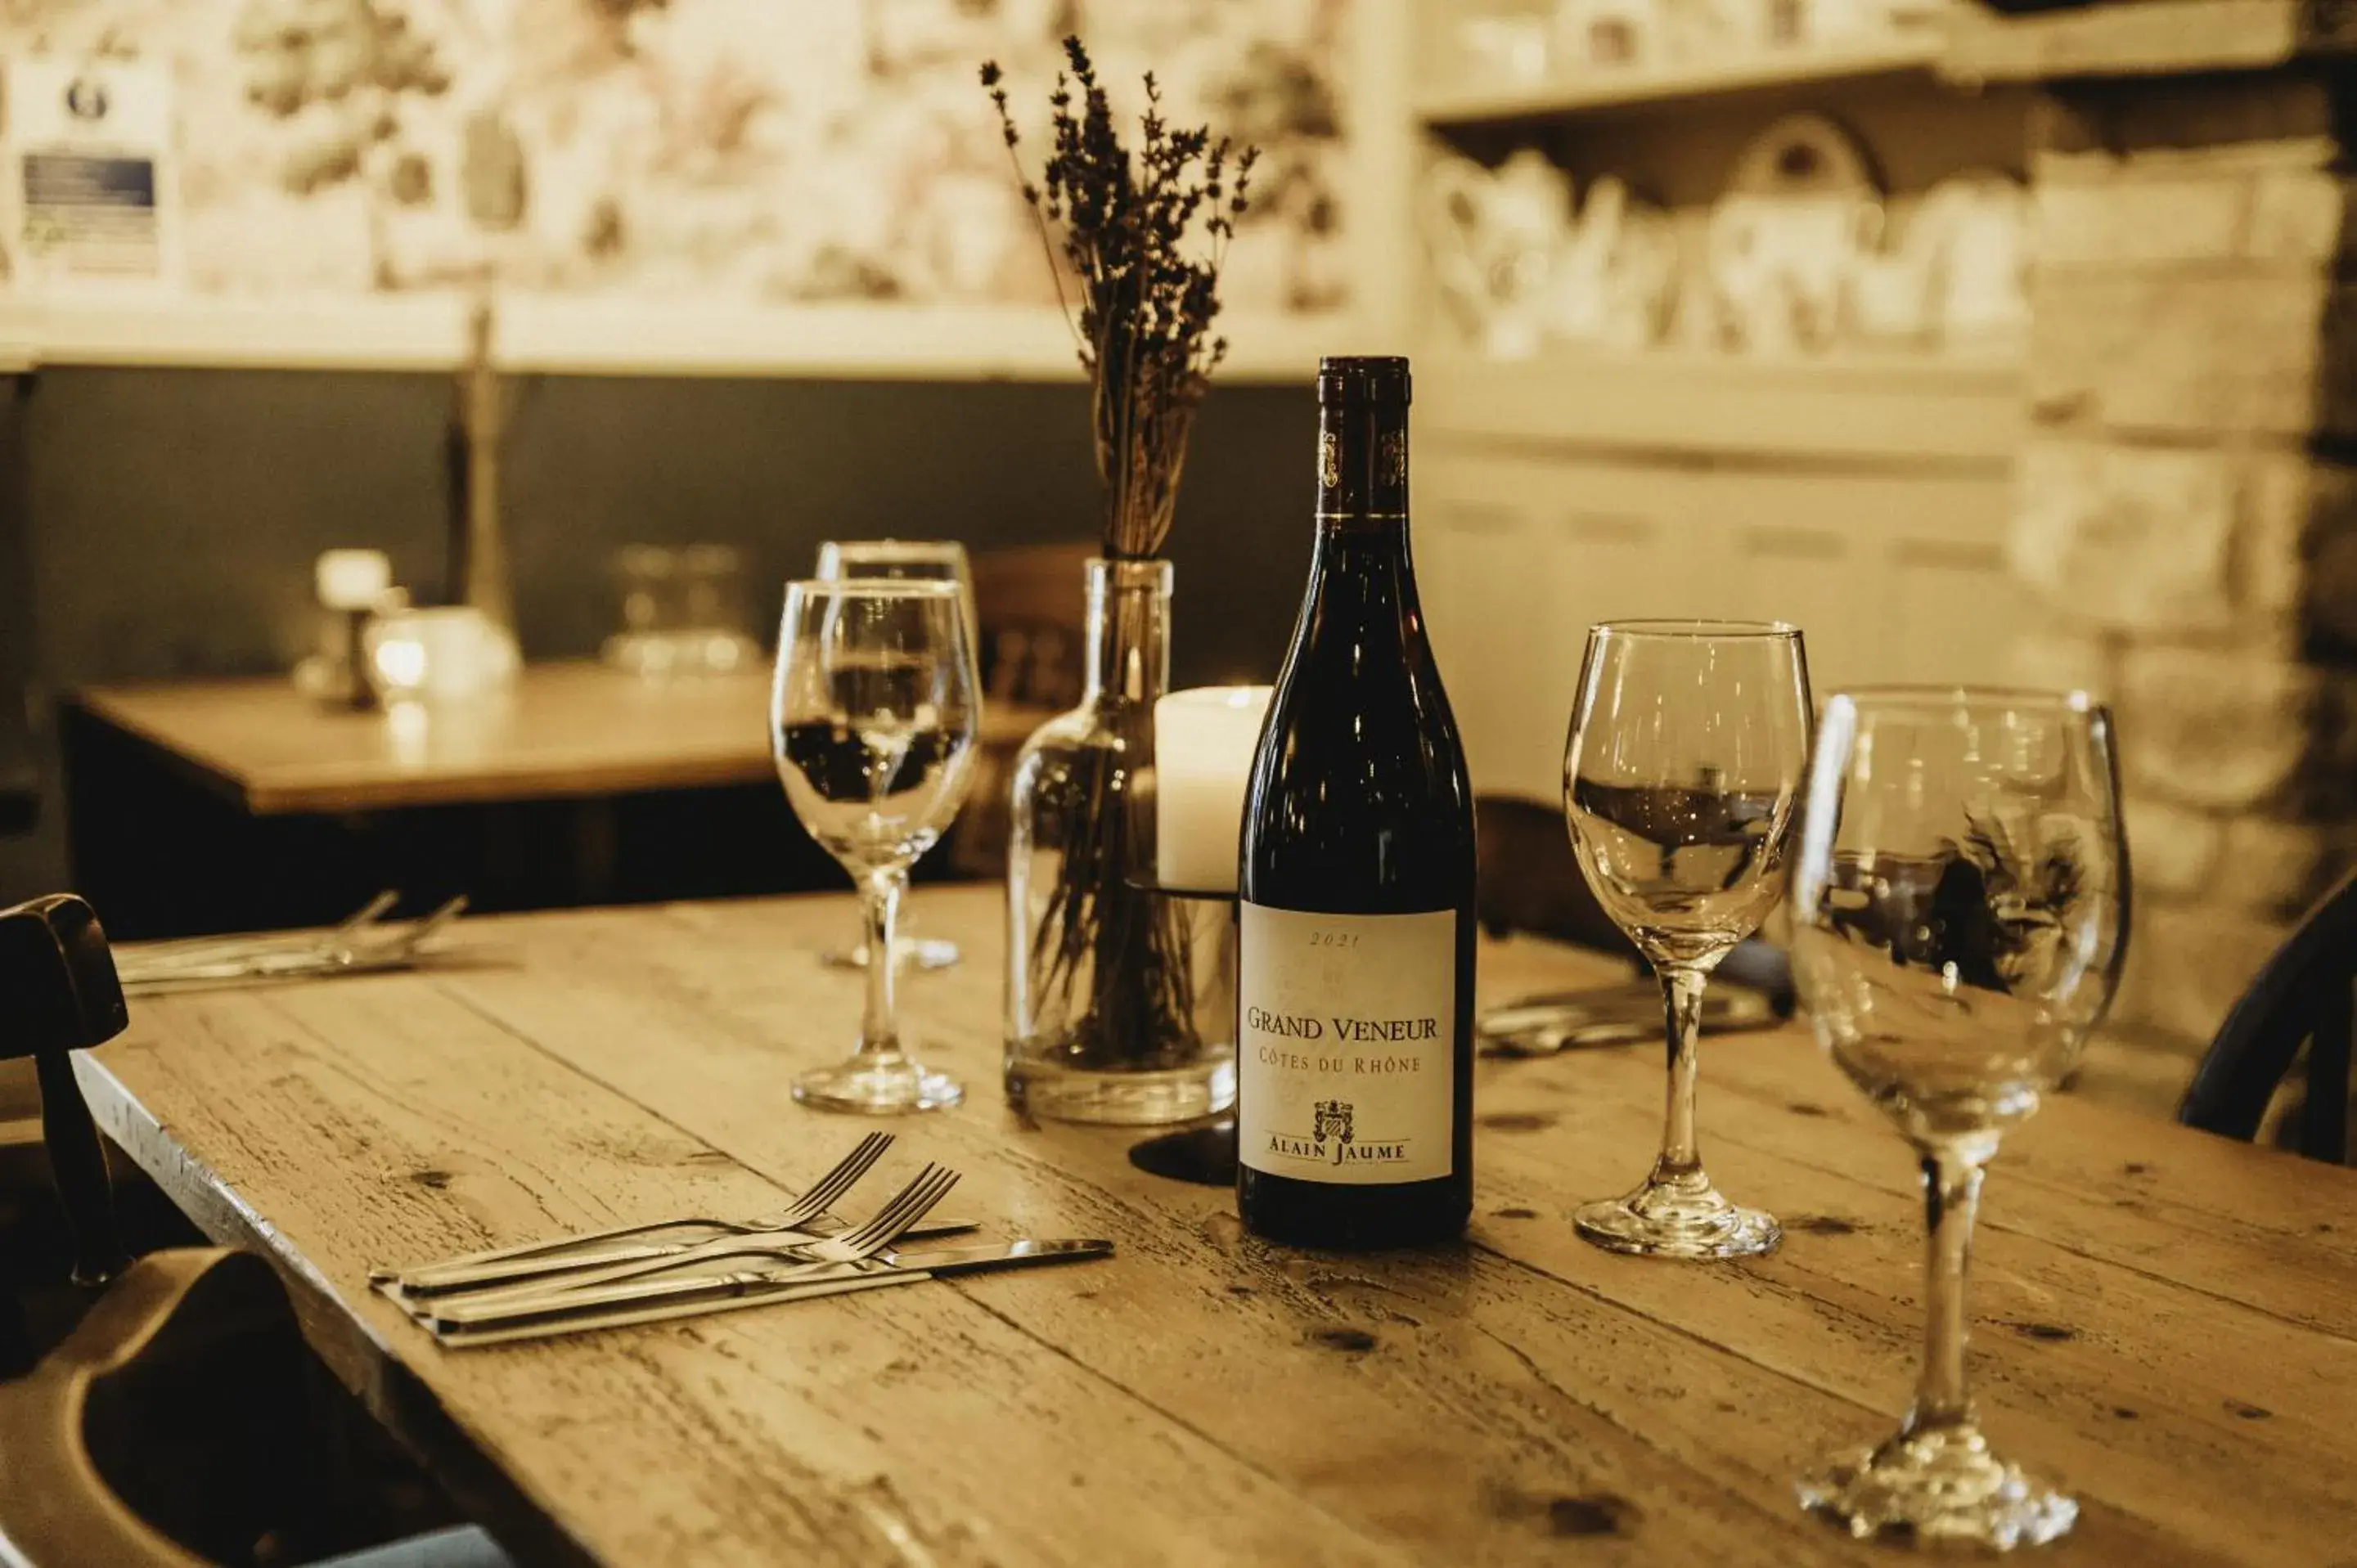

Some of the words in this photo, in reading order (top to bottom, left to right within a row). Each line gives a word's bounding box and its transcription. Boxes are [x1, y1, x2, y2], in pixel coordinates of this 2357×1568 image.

[1309, 932, 1358, 947] 2021
[1248, 1007, 1322, 1040] GRAND
[1333, 1018, 1437, 1041] VENEUR
[1259, 1045, 1308, 1070] CÔTES
[1319, 1058, 1343, 1072] DU
[1354, 1055, 1420, 1073] RHÔNE
[1269, 1137, 1325, 1157] ALAIN
[1331, 1143, 1405, 1166] JAUME
